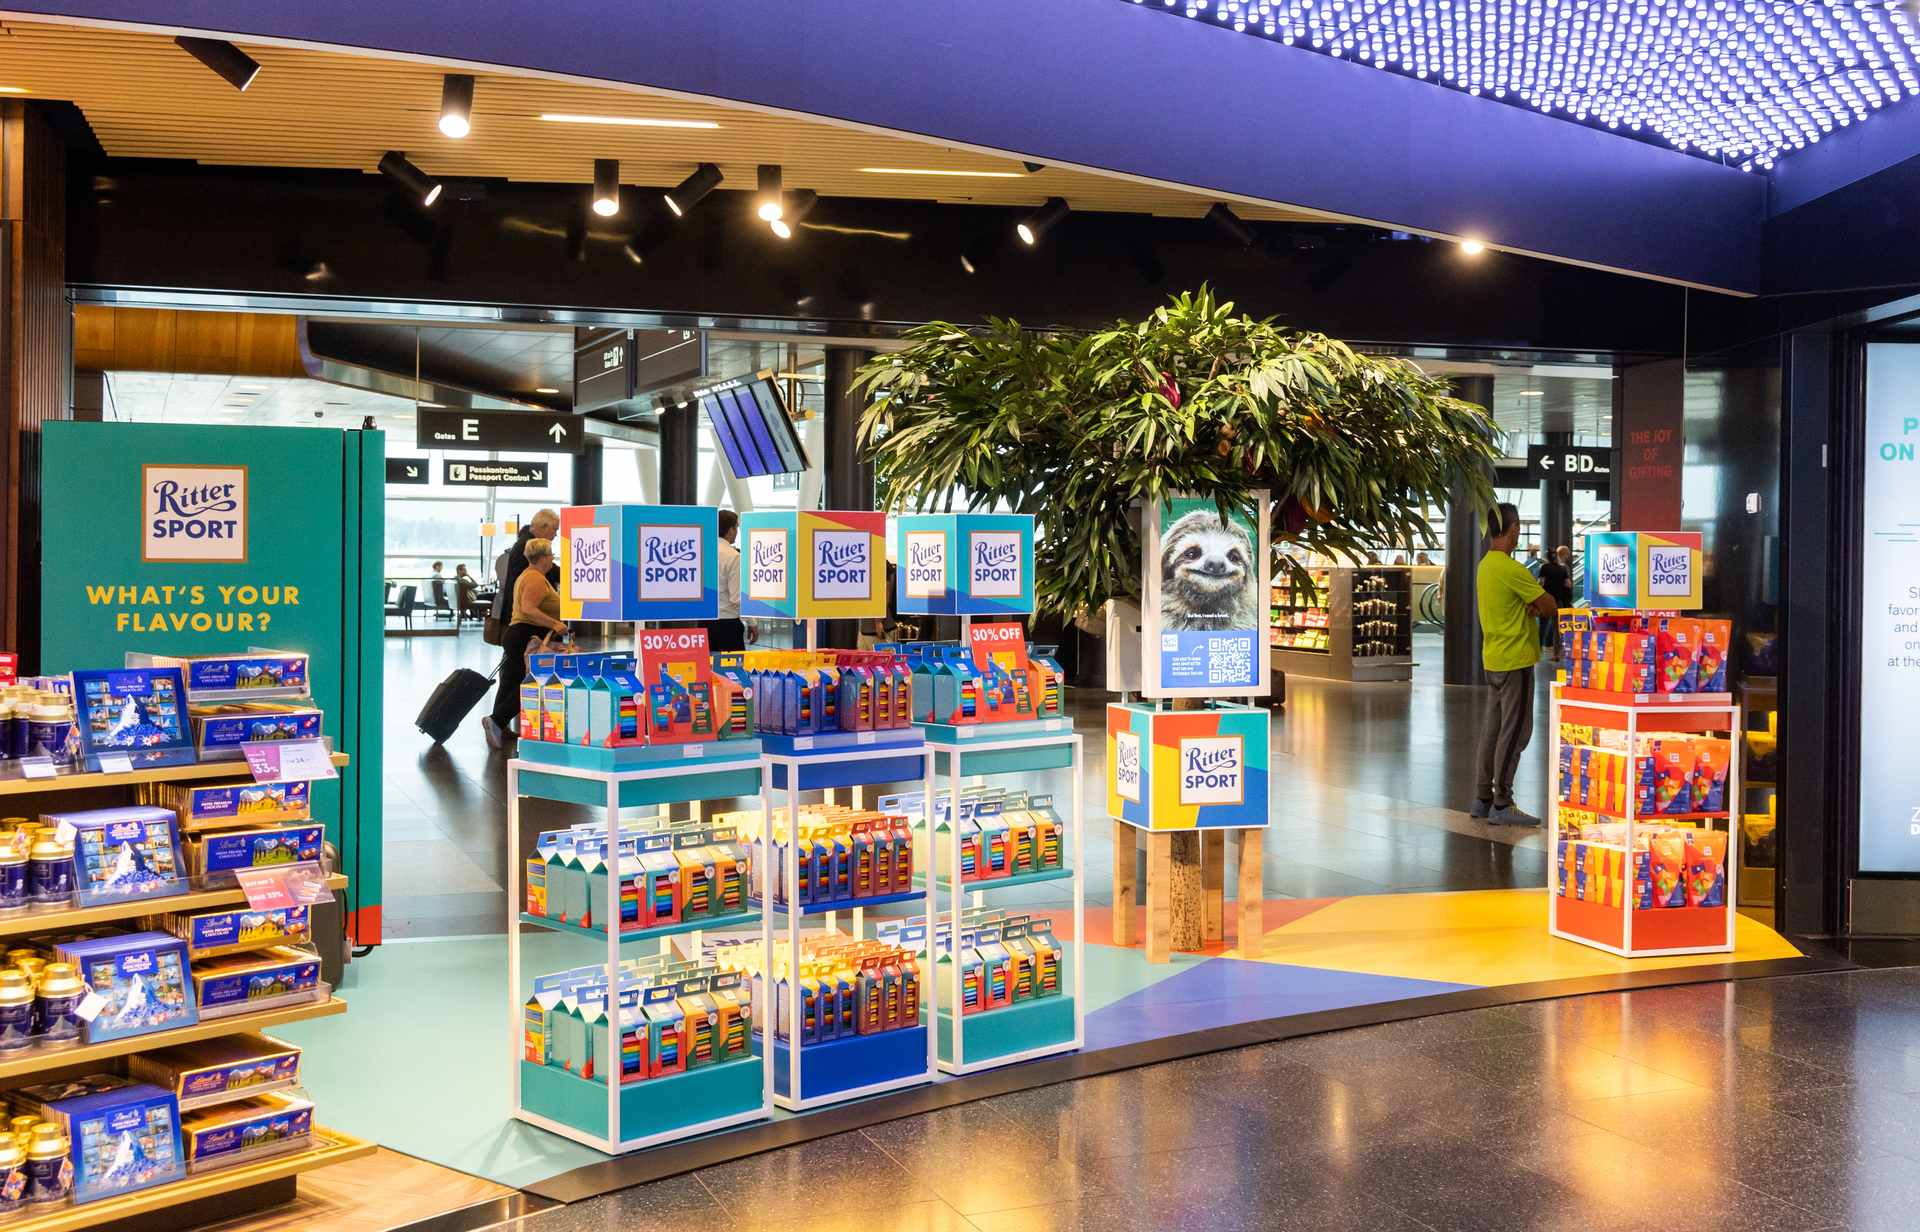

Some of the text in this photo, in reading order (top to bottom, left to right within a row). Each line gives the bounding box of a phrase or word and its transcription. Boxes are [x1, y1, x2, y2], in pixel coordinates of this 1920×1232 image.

[434, 418, 480, 441] Gates E
[1630, 429, 1672, 444] THE JOY
[1643, 448, 1658, 461] OF
[1880, 443, 1914, 462] ON
[469, 466, 518, 475] Passkontrolle
[469, 474, 530, 482] Passport Control
[1629, 465, 1672, 479] GIFTING
[153, 480, 238, 518] Ritter
[152, 520, 238, 538] SPORT
[574, 537, 607, 566] Ritter
[644, 536, 697, 566] Ritter
[752, 540, 784, 567] Ritter
[818, 540, 866, 568] Ritter
[910, 542, 942, 568] Ritter
[974, 541, 1016, 567] Ritter
[1601, 552, 1626, 573] Ritter
[1652, 552, 1688, 574] Ritter
[574, 568, 607, 583] SPORT
[644, 567, 697, 582] SPORT
[752, 568, 784, 583] SPORT
[818, 569, 866, 584] SPORT
[910, 568, 942, 582] SPORT
[974, 568, 1016, 582] SPORT
[1600, 573, 1626, 585] SPORT
[1652, 573, 1688, 585] SPORT
[86, 586, 300, 606] WHAT'S YOUR
[116, 613, 271, 632] FLAVOUR?
[1894, 621, 1918, 633] and
[644, 634, 706, 650] 30% OFF
[972, 627, 1021, 642] 30% OFF
[1888, 656, 1900, 667] at
[1118, 740, 1137, 768] Ritter
[1185, 746, 1237, 774] Ritter
[253, 762, 279, 774] 33%
[1118, 768, 1137, 784] SPORT
[1185, 774, 1237, 789] SPORT
[248, 890, 284, 902] SAVE 33%
